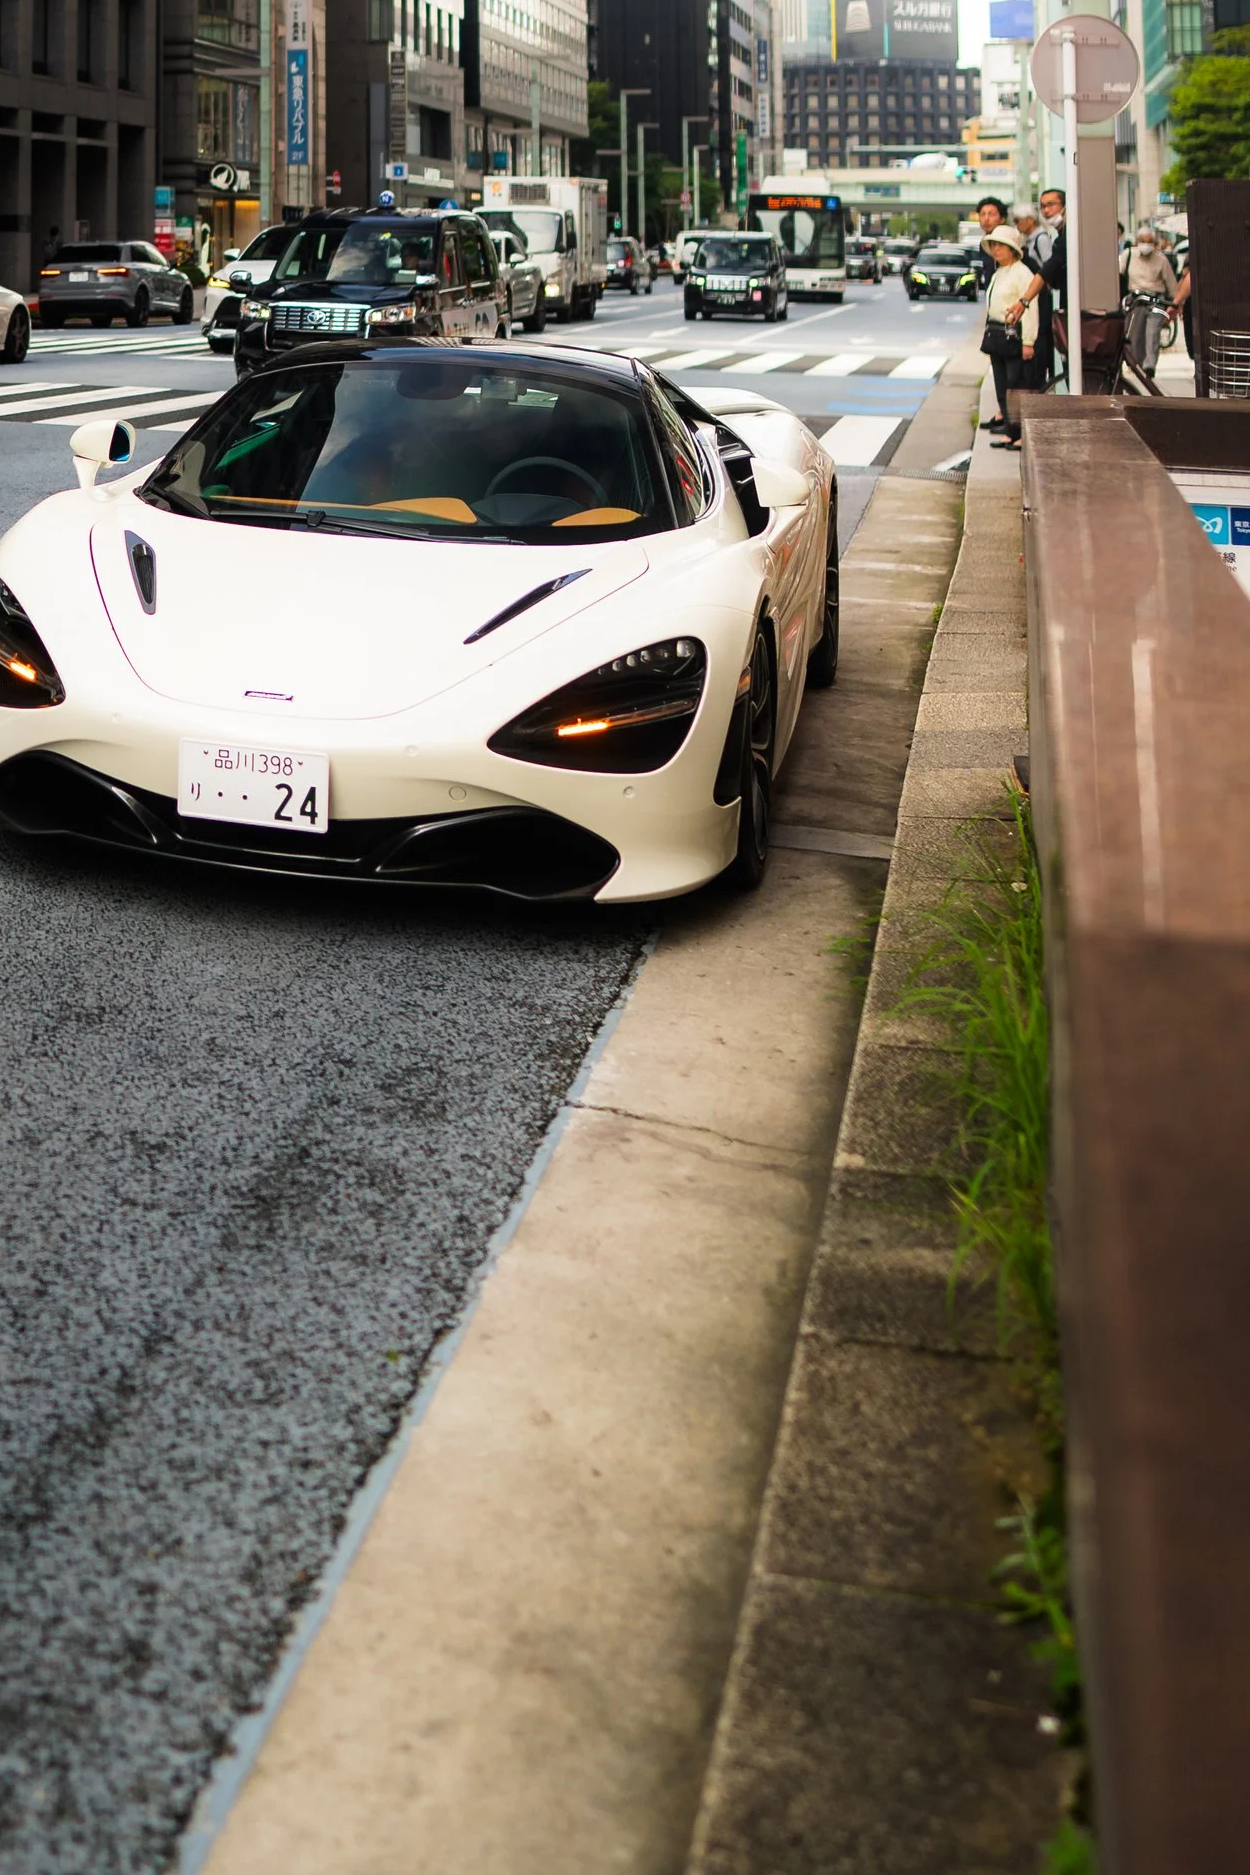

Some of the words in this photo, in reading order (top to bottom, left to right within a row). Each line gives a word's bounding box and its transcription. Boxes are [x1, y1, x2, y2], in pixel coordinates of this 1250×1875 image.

[893, 0, 952, 18] スルガ銀行
[292, 76, 305, 145] 東急リバブル
